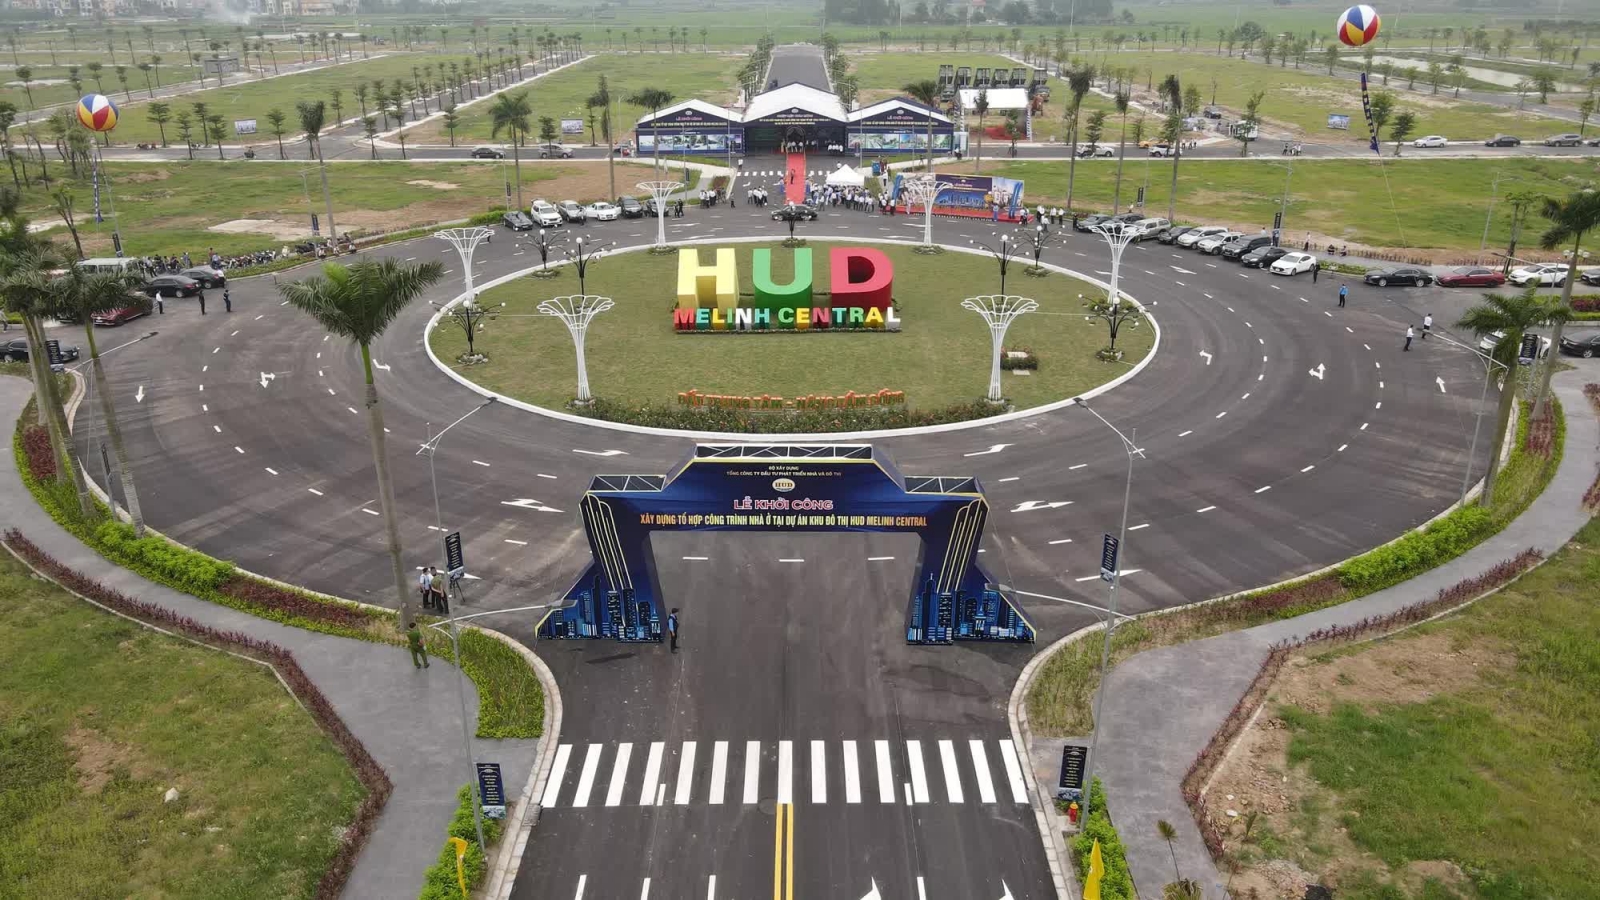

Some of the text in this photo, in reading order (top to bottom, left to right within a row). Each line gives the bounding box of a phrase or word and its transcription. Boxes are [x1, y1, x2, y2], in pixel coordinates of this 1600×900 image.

[677, 246, 894, 312] HUD
[674, 306, 901, 330] MELINH CENTRAL
[734, 496, 833, 510] LỄ KHỞI CÔNG
[640, 512, 654, 525] XÂY
[656, 513, 676, 527] DỰNG
[688, 513, 703, 527] HỢP
[705, 512, 724, 525] CÔNG
[726, 513, 747, 526] TRÌNH
[749, 513, 764, 526] NHÀ
[766, 512, 771, 525] Ở
[773, 515, 784, 527] TẠI
[786, 514, 796, 528] DỰ
[798, 513, 807, 525] ÁN
[809, 516, 824, 526] KHU
[825, 514, 835, 525] ĐÔ
[837, 515, 849, 527] THỊ
[850, 516, 864, 526] HUD
[866, 516, 894, 526] MELINH
[896, 516, 927, 526] CENTRAL
